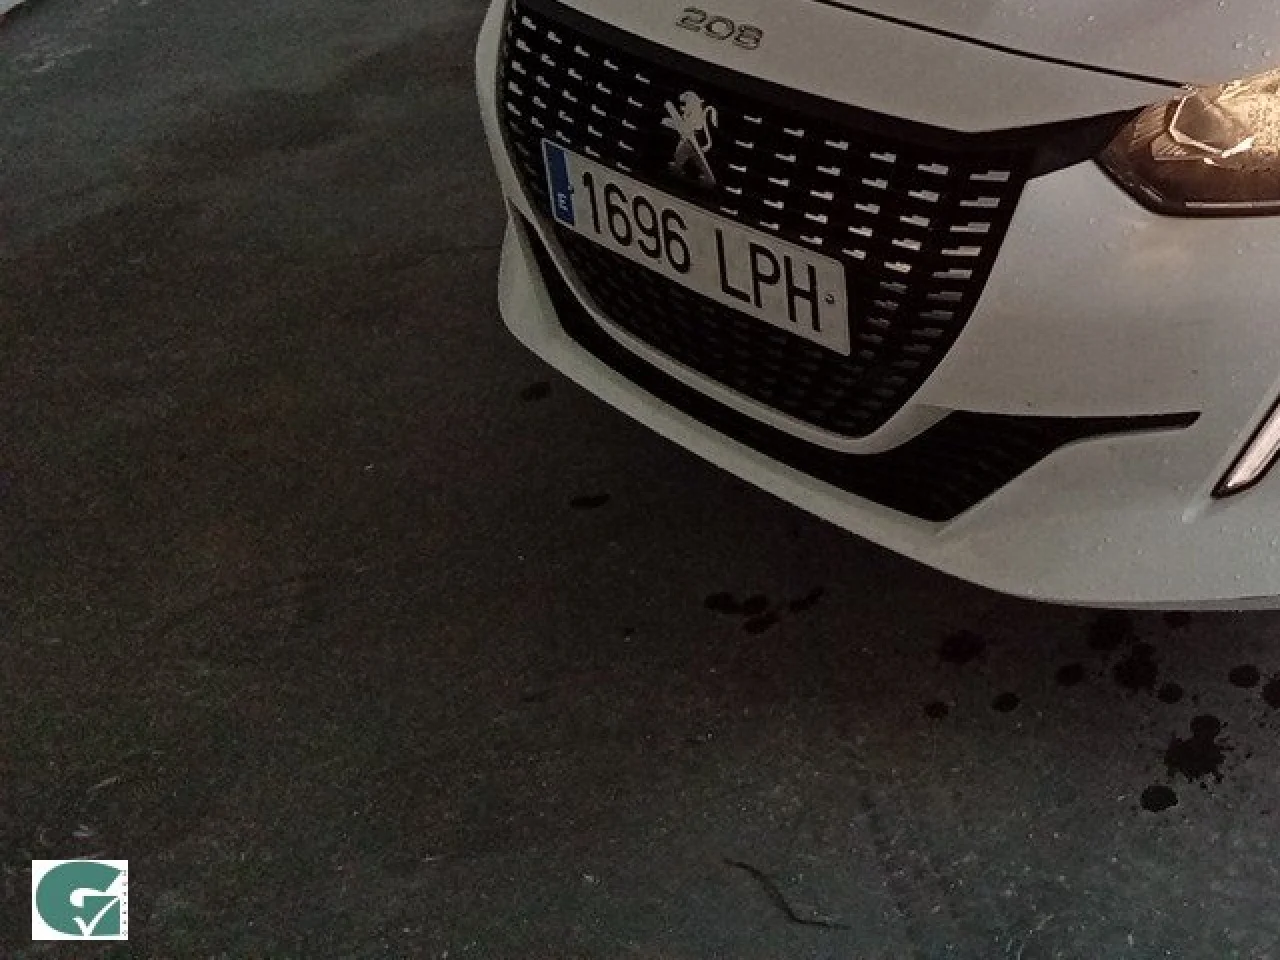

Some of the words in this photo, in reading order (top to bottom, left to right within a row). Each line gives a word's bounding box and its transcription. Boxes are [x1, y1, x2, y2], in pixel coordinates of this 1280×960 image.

[675, 6, 763, 50] 208
[583, 171, 692, 276] 1696
[714, 228, 822, 333] LPH
